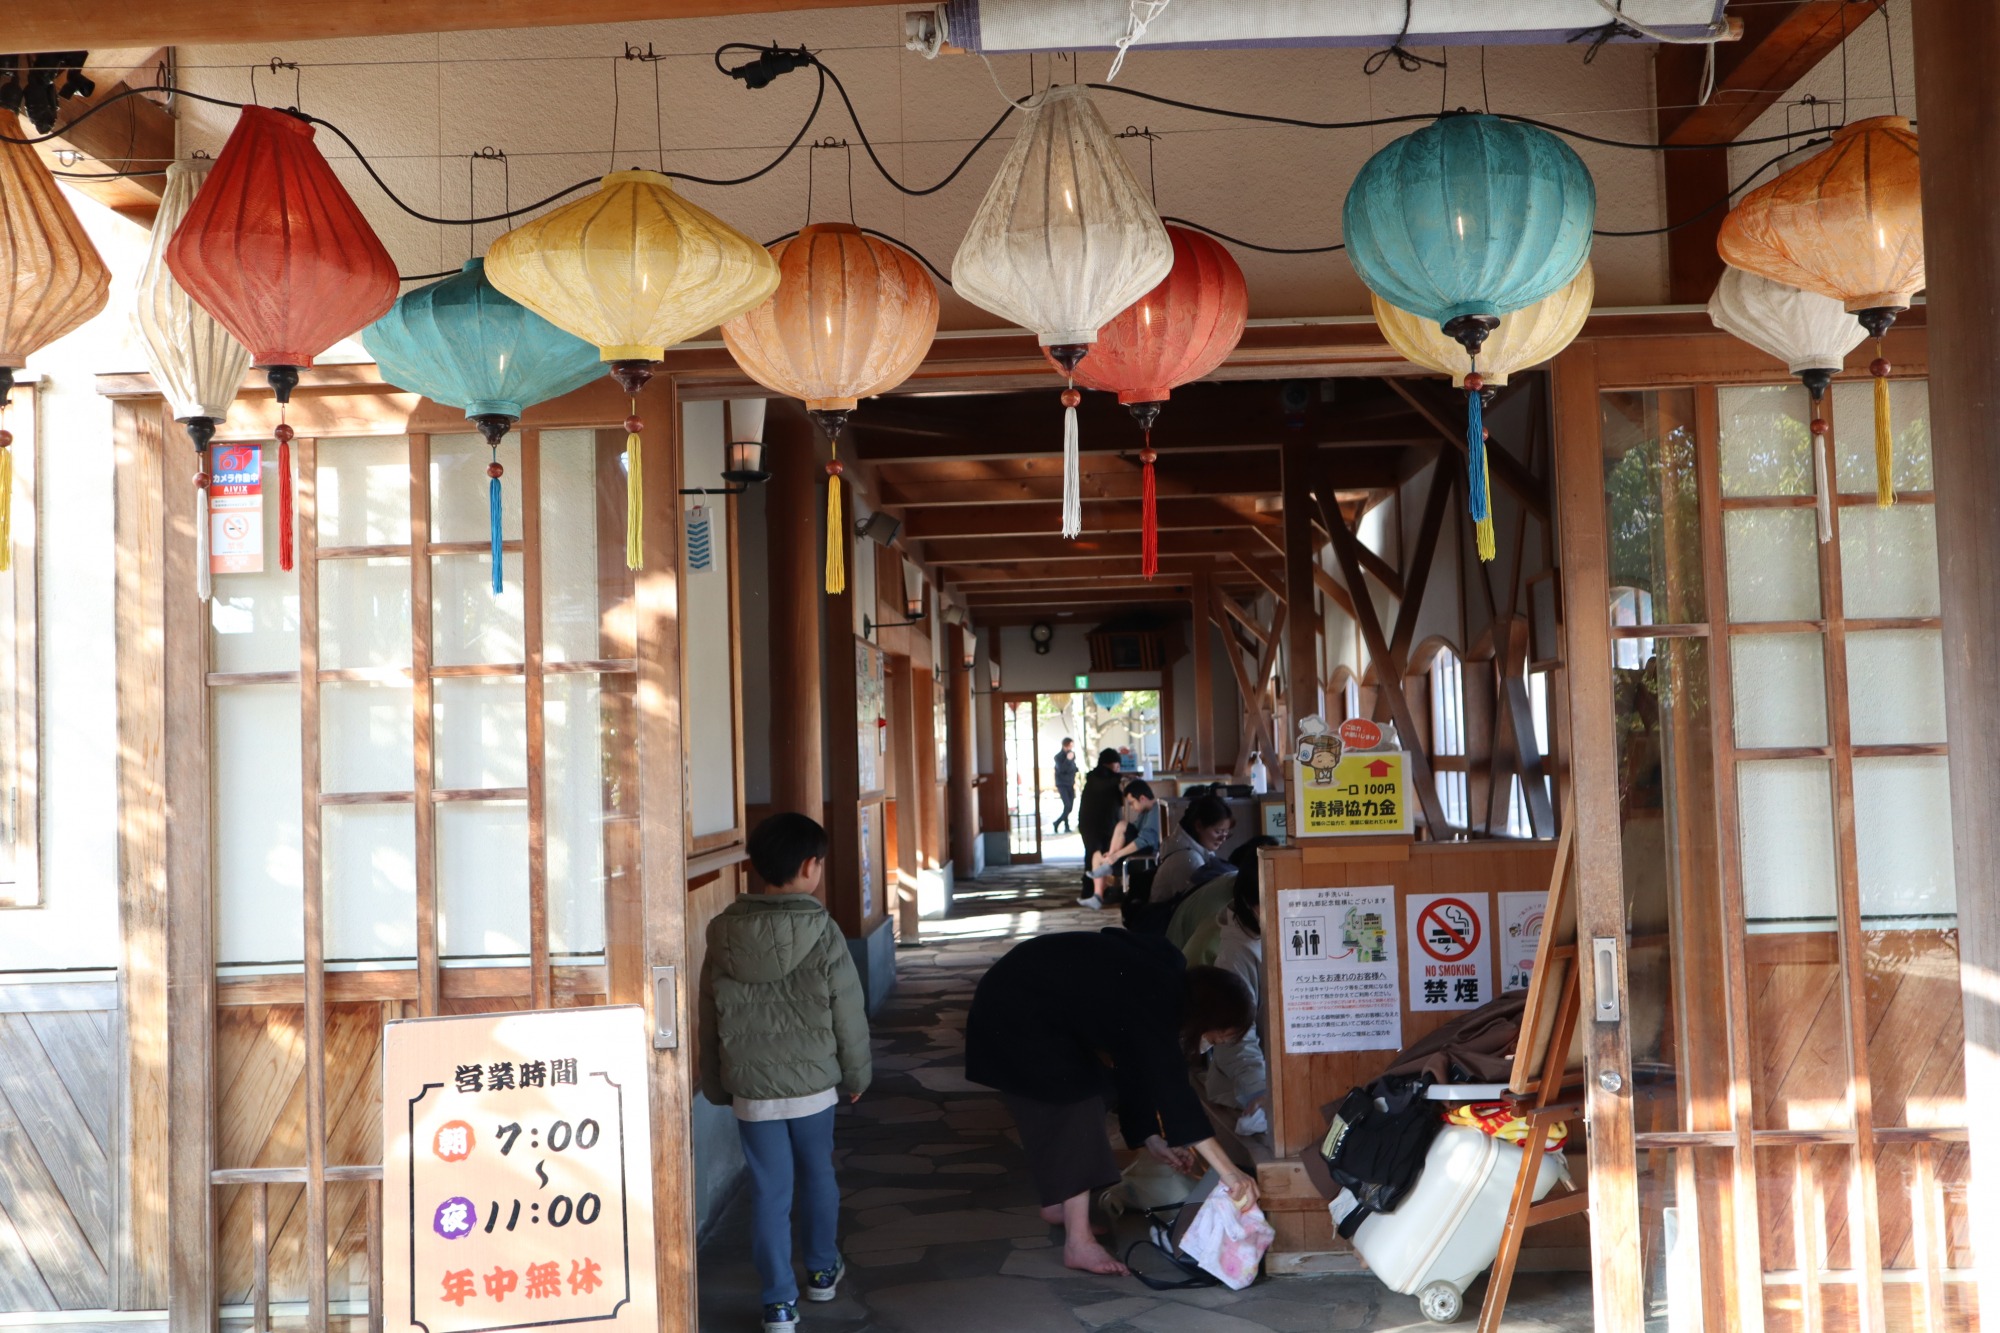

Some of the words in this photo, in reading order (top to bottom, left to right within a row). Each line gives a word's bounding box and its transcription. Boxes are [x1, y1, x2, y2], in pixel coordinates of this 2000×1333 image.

[213, 473, 258, 483] カメラ作動中
[1364, 783, 1396, 795] 100円
[1310, 799, 1396, 818] 清掃協力金
[1425, 965, 1437, 977] NO
[1438, 964, 1476, 977] SMOKING
[1424, 978, 1479, 1004] 禁煙
[455, 1058, 578, 1093] 営業時間
[438, 1126, 467, 1156] 朝
[495, 1118, 600, 1157] 7:00
[439, 1203, 469, 1233] 夜
[484, 1192, 601, 1234] 11:00
[440, 1257, 603, 1307] 年中無休
